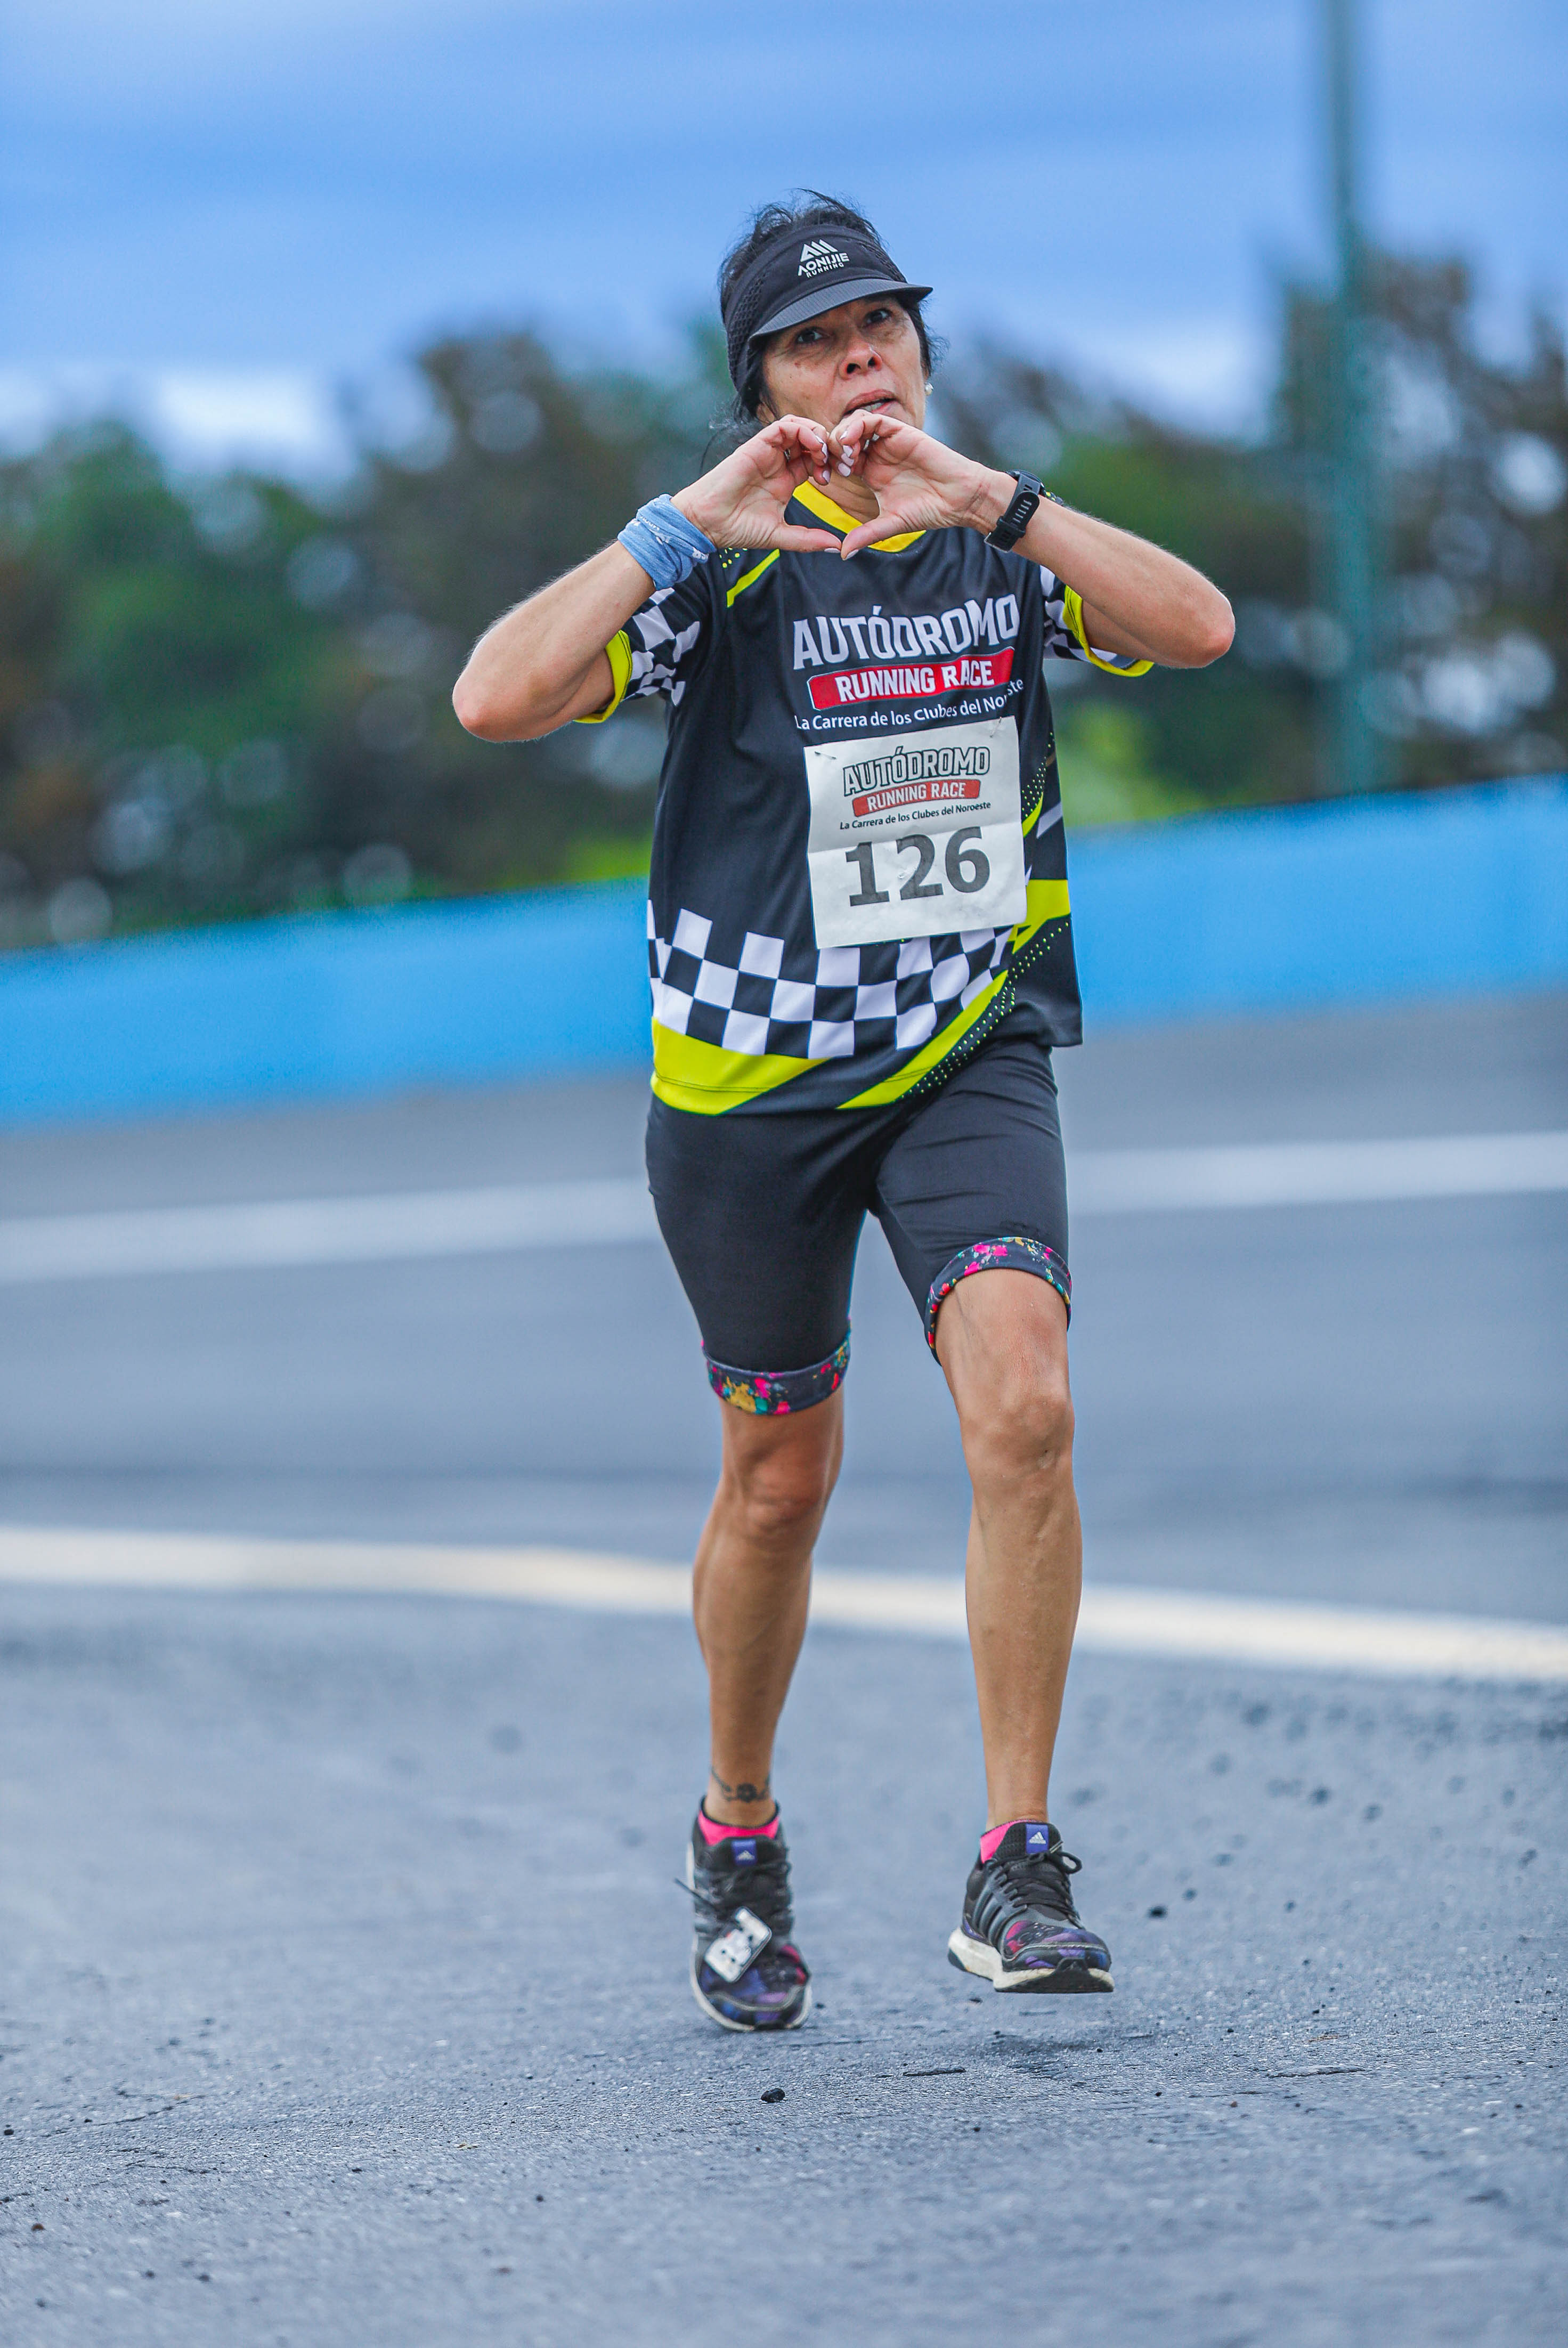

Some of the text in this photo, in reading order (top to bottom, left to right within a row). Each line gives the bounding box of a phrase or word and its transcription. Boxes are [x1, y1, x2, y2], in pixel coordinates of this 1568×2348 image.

[798, 253, 850, 276] AONIJIE
[806, 262, 844, 278] RUNNING
[793, 593, 1020, 670] AUTÓDROMO
[834, 659, 995, 703] RUNNING RACE
[794, 715, 810, 730] La
[812, 714, 868, 730] Carrera
[870, 711, 888, 726] de
[890, 710, 912, 725] los
[914, 703, 957, 721] Clubes
[960, 698, 982, 716] del
[843, 746, 990, 797] AUTÓDROMO
[867, 782, 966, 812] RUNNING RACE
[852, 818, 883, 828] Carrera
[885, 815, 896, 824] de
[898, 813, 910, 822] los
[912, 809, 939, 819] Clubes
[941, 805, 954, 815] del
[956, 802, 991, 813] Noroeste
[845, 826, 990, 907] 126
